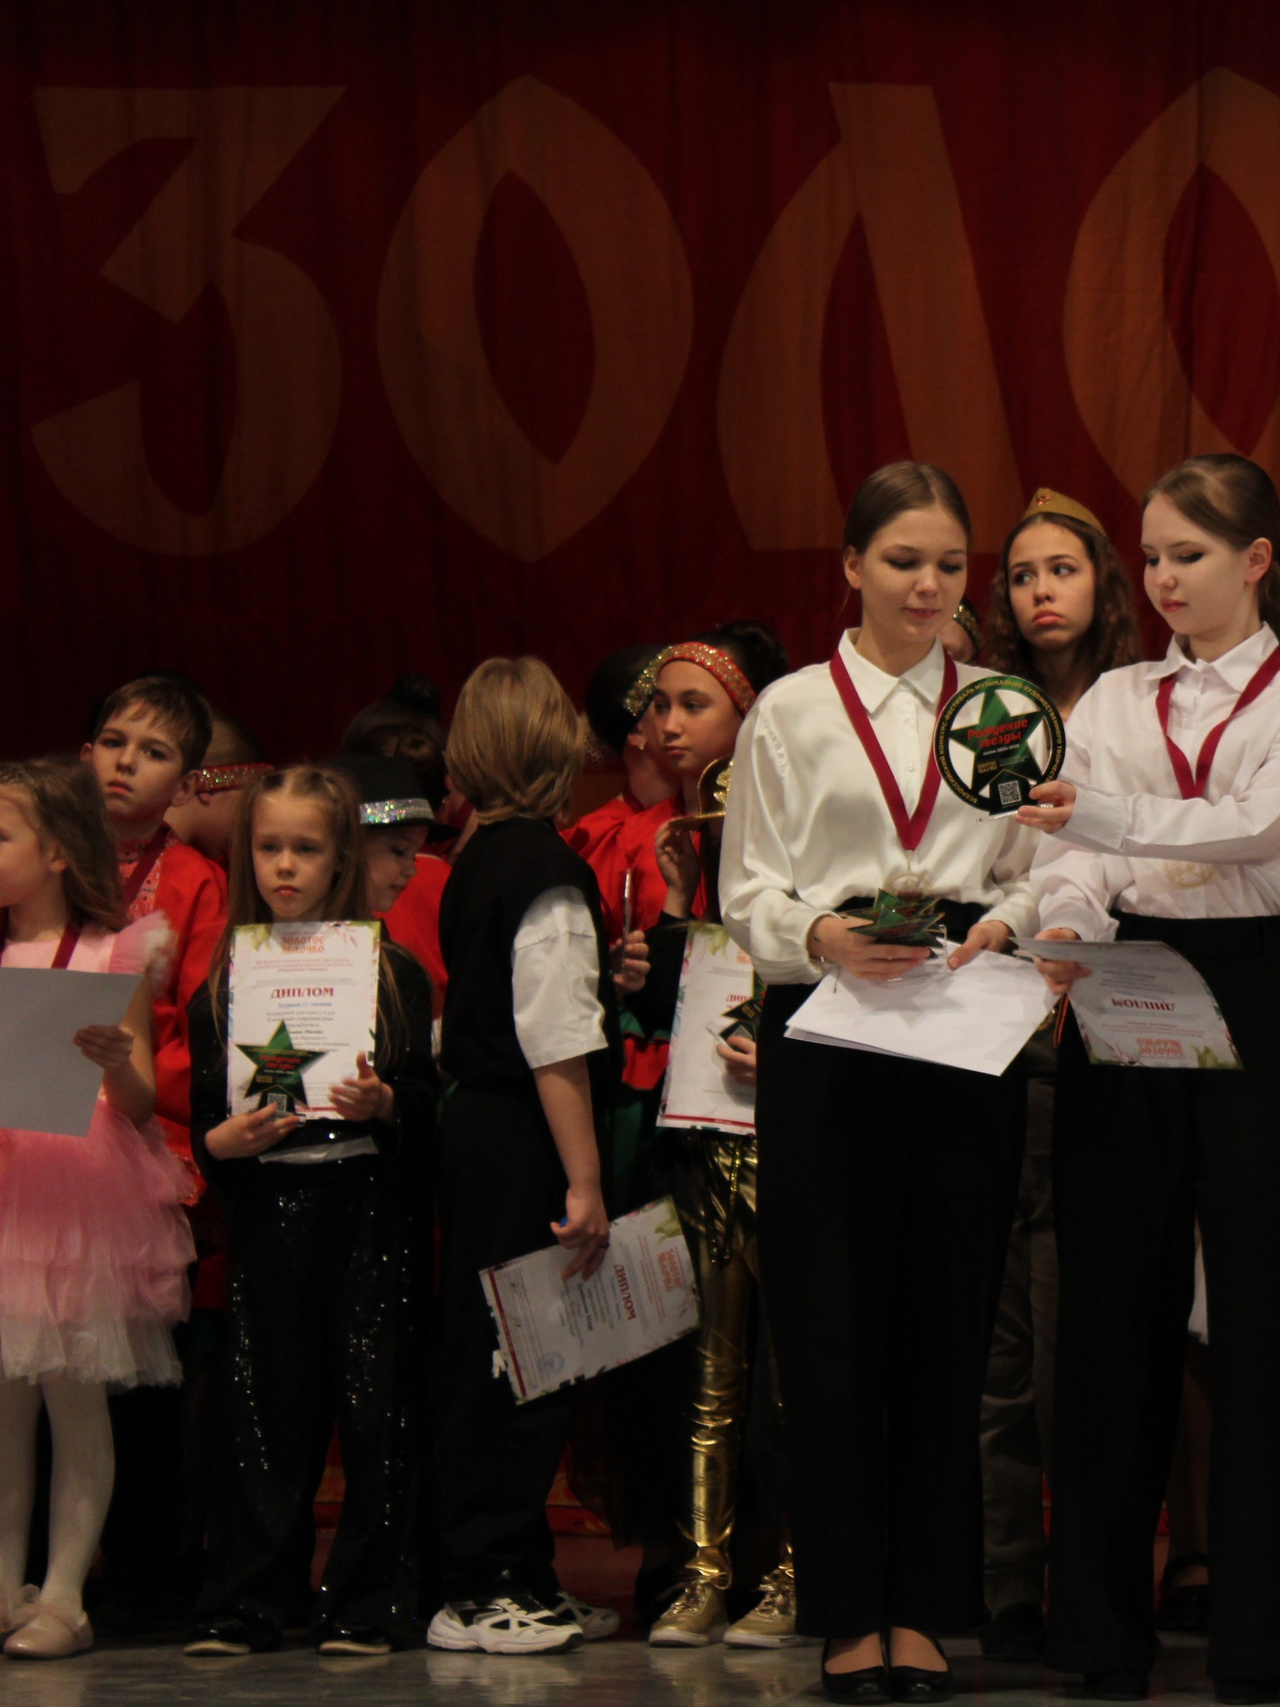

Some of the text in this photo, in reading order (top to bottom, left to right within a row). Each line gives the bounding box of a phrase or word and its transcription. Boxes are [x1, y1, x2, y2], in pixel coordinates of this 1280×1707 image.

[967, 719, 1028, 740] Рождение
[979, 731, 1022, 749] звезды
[1045, 746, 1063, 784] ТВОРЧЕСТВ
[270, 987, 334, 1000] ДИПЛОМ
[1111, 998, 1175, 1011] ДИПЛОМ
[613, 1264, 637, 1321] ДИПЛОМ
